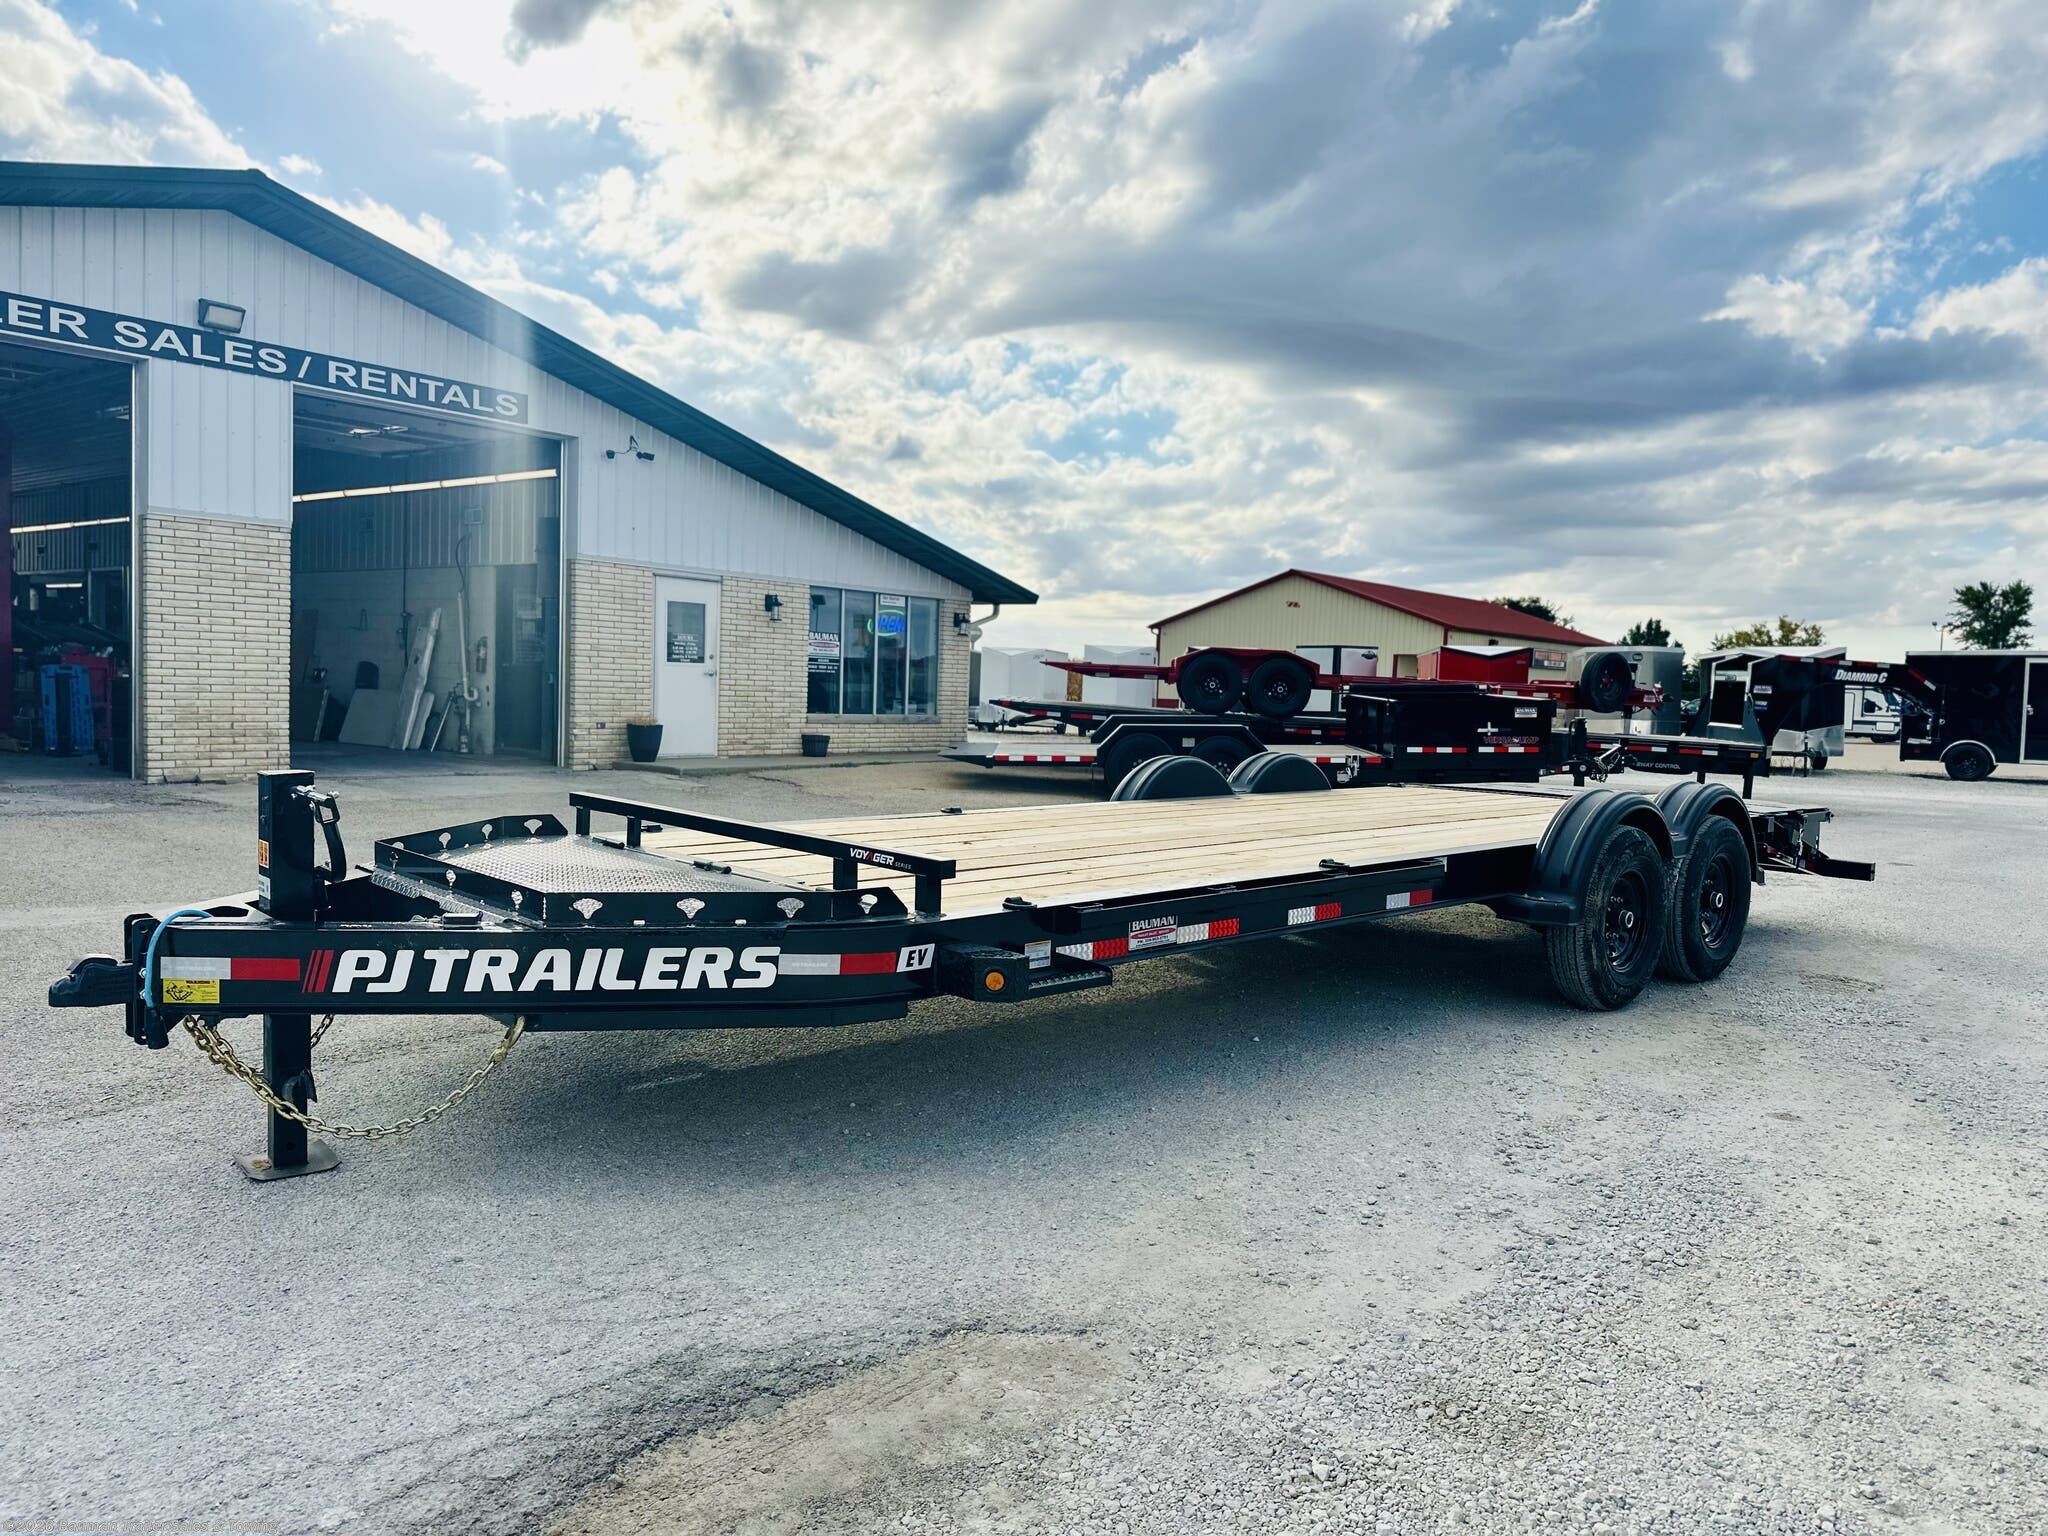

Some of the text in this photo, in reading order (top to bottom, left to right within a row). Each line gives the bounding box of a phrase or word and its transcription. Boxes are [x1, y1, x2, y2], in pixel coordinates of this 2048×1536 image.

[0, 298, 519, 417] ER SALES / RENTALS
[1834, 669, 1888, 684] DIAMOND C
[849, 847, 895, 866] VOYAGER
[1132, 915, 1175, 932] BAUMAN
[905, 948, 929, 968] EV
[331, 946, 782, 993] PJ TRAILERS
